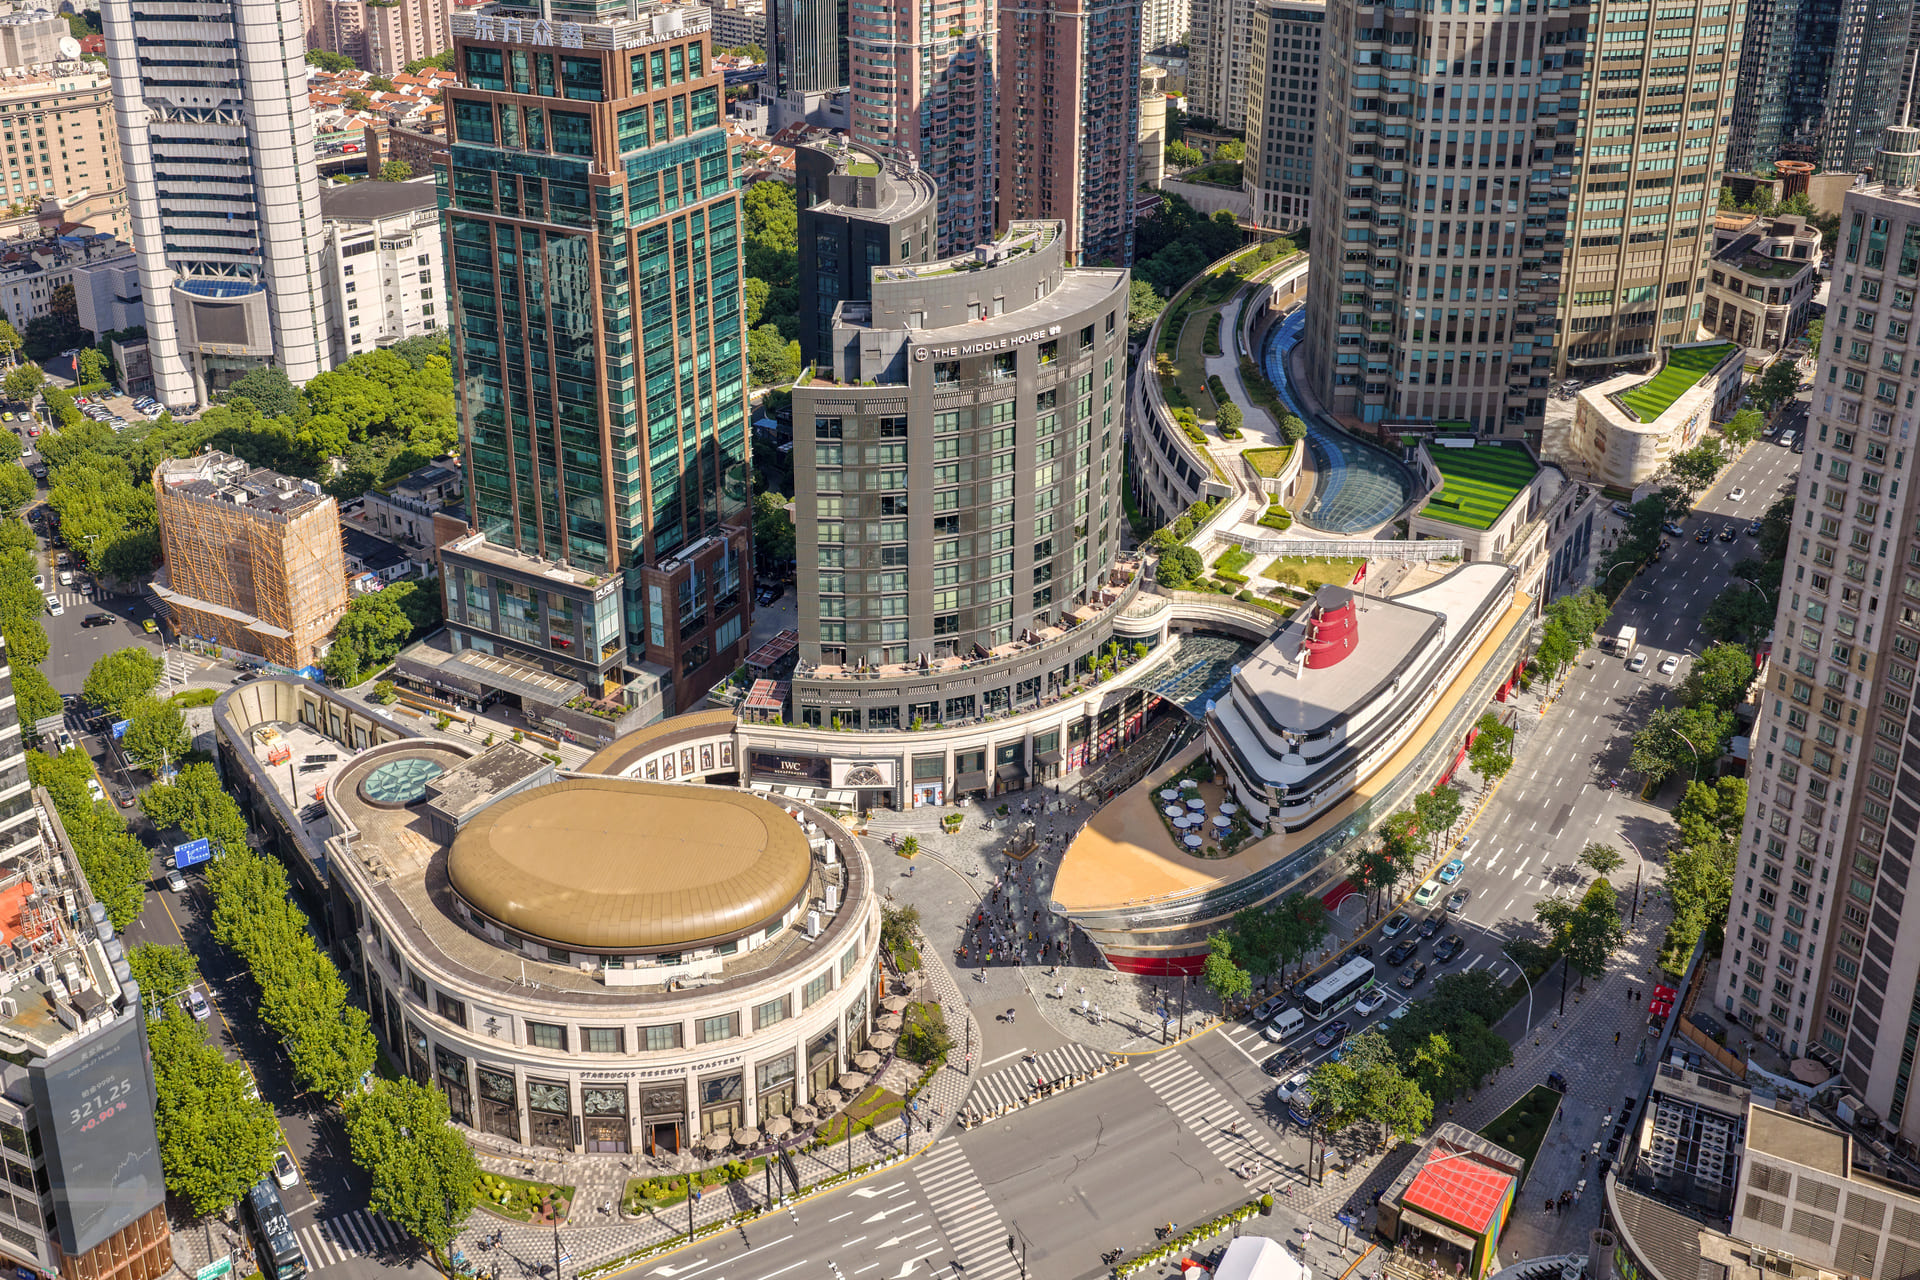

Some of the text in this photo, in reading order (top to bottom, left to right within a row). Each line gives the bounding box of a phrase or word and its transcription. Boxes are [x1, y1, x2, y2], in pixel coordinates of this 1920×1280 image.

[625, 23, 709, 49] ORIENTAL CENTER
[932, 347, 957, 358] THE
[962, 338, 1007, 355] MIDDLE
[1010, 330, 1046, 346] HOUSE
[596, 581, 615, 598] PURE
[780, 761, 801, 770] IWC
[579, 1055, 742, 1079] STARBUCKS RESERVE ROASTERY
[70, 1078, 131, 1124] 321.25
